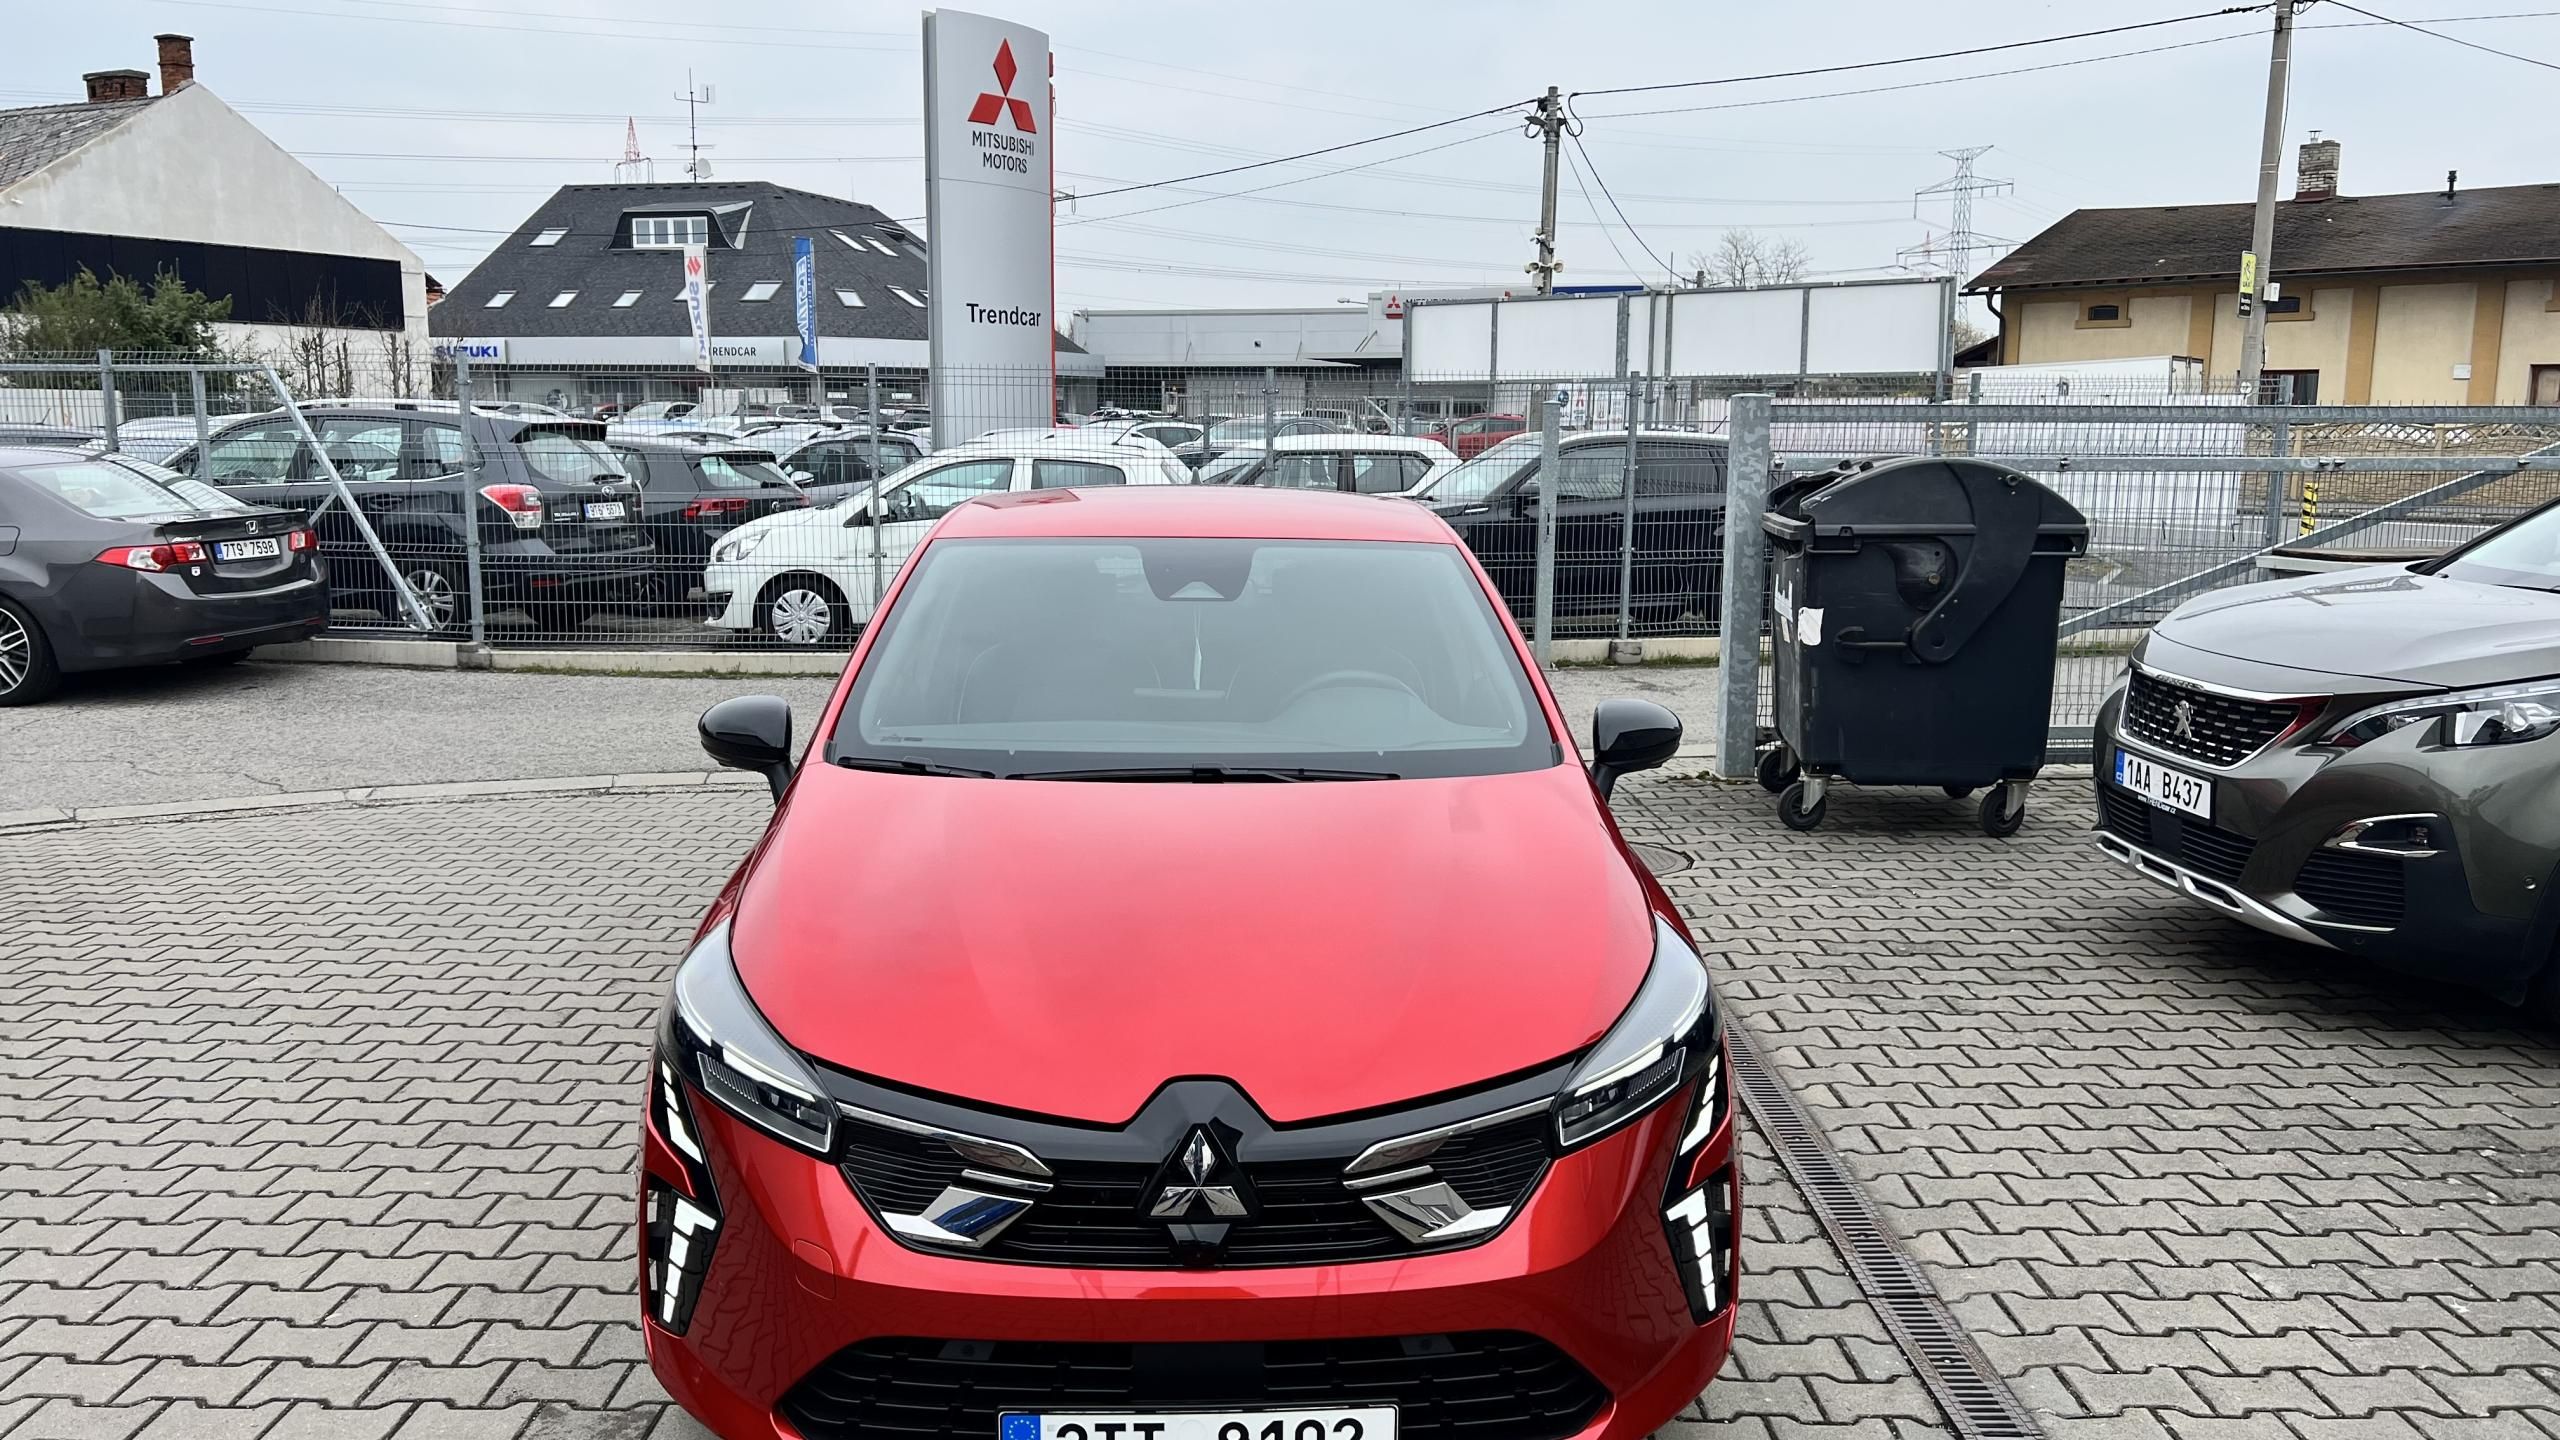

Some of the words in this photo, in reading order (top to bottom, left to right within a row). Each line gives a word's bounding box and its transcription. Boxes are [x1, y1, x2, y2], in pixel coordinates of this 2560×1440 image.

[972, 130, 1034, 156] MITSUBISHI
[983, 152, 1027, 174] MOTORS
[966, 303, 1041, 327] Trendcar
[709, 346, 757, 357] RENDCAR
[223, 543, 244, 558] 7T9
[250, 541, 275, 555] 7598
[2127, 759, 2151, 793] 1AA
[2162, 771, 2203, 810] B437
